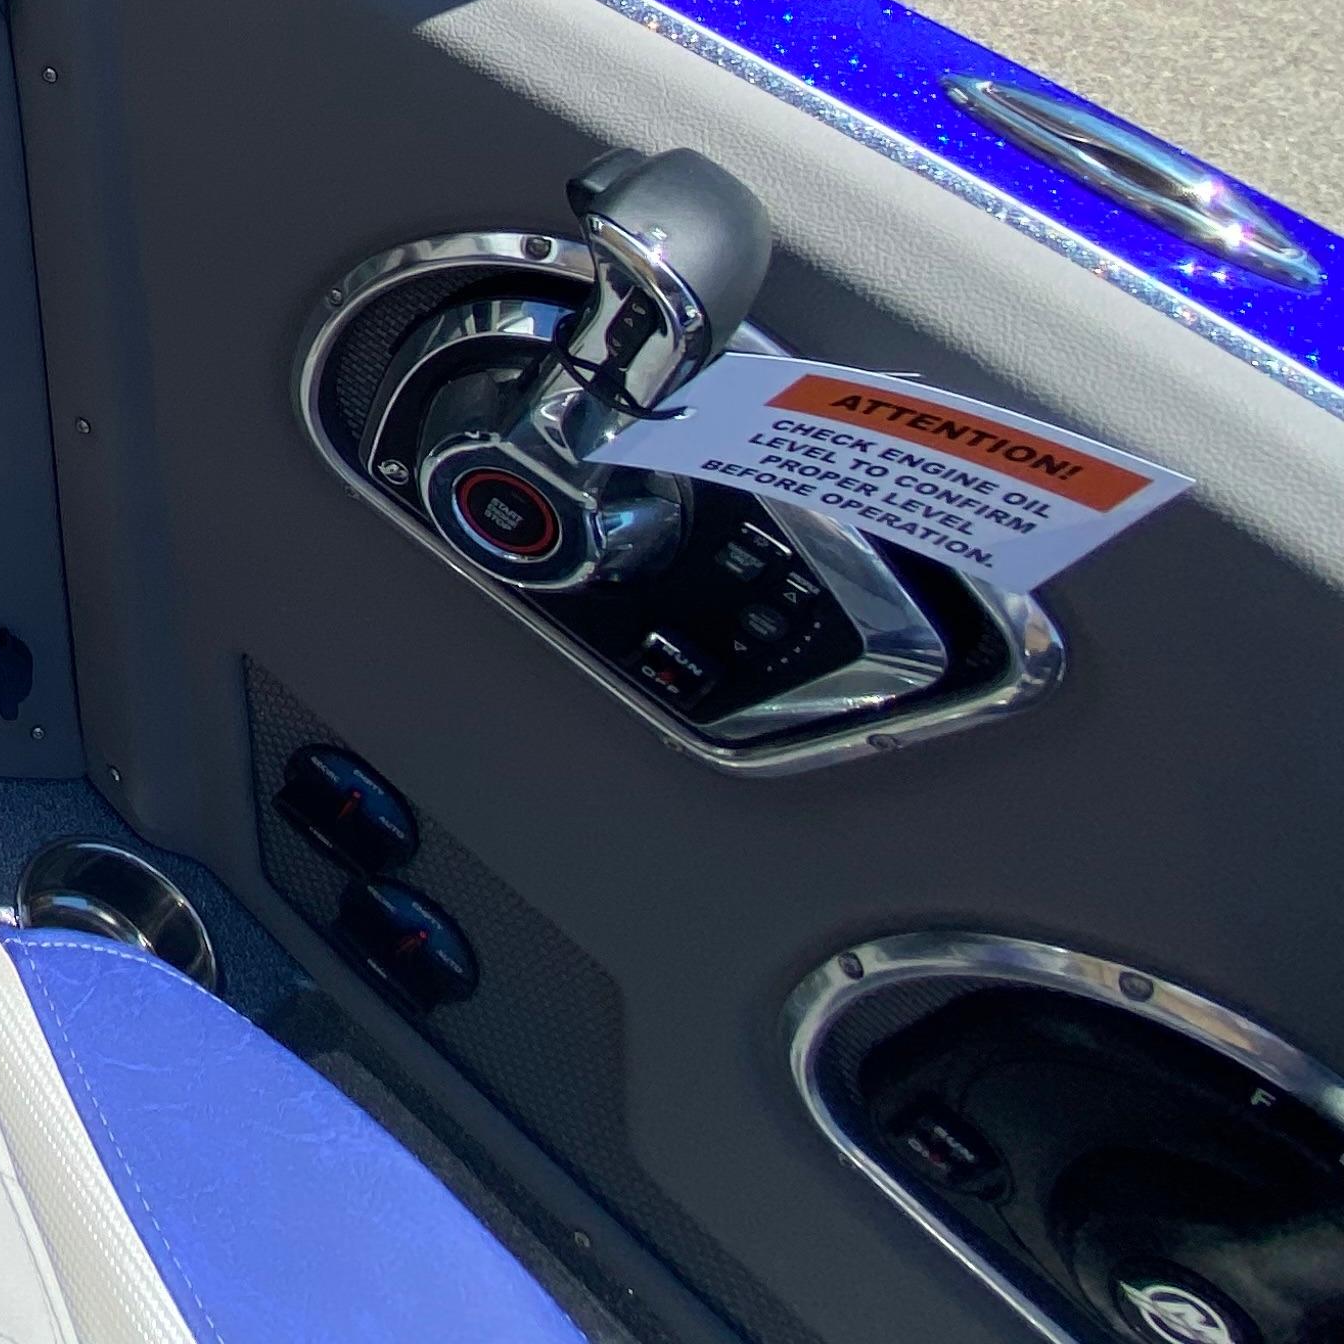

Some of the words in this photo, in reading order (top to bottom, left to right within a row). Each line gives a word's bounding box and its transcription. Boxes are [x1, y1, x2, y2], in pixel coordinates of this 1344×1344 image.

[748, 432, 837, 466] LEVEL
[849, 457, 891, 479] TO
[894, 471, 1035, 535] CONFIRM
[772, 418, 880, 454] CHECK
[883, 442, 998, 496] ENGINE
[1002, 490, 1050, 519] OIL
[829, 394, 1083, 481] ATTENTION!
[701, 459, 811, 497] BEFORE
[821, 492, 994, 568] OPERATION.
[761, 454, 887, 498] PROPER
[888, 490, 974, 536] LEVEL
[379, 816, 405, 839] AUTO
